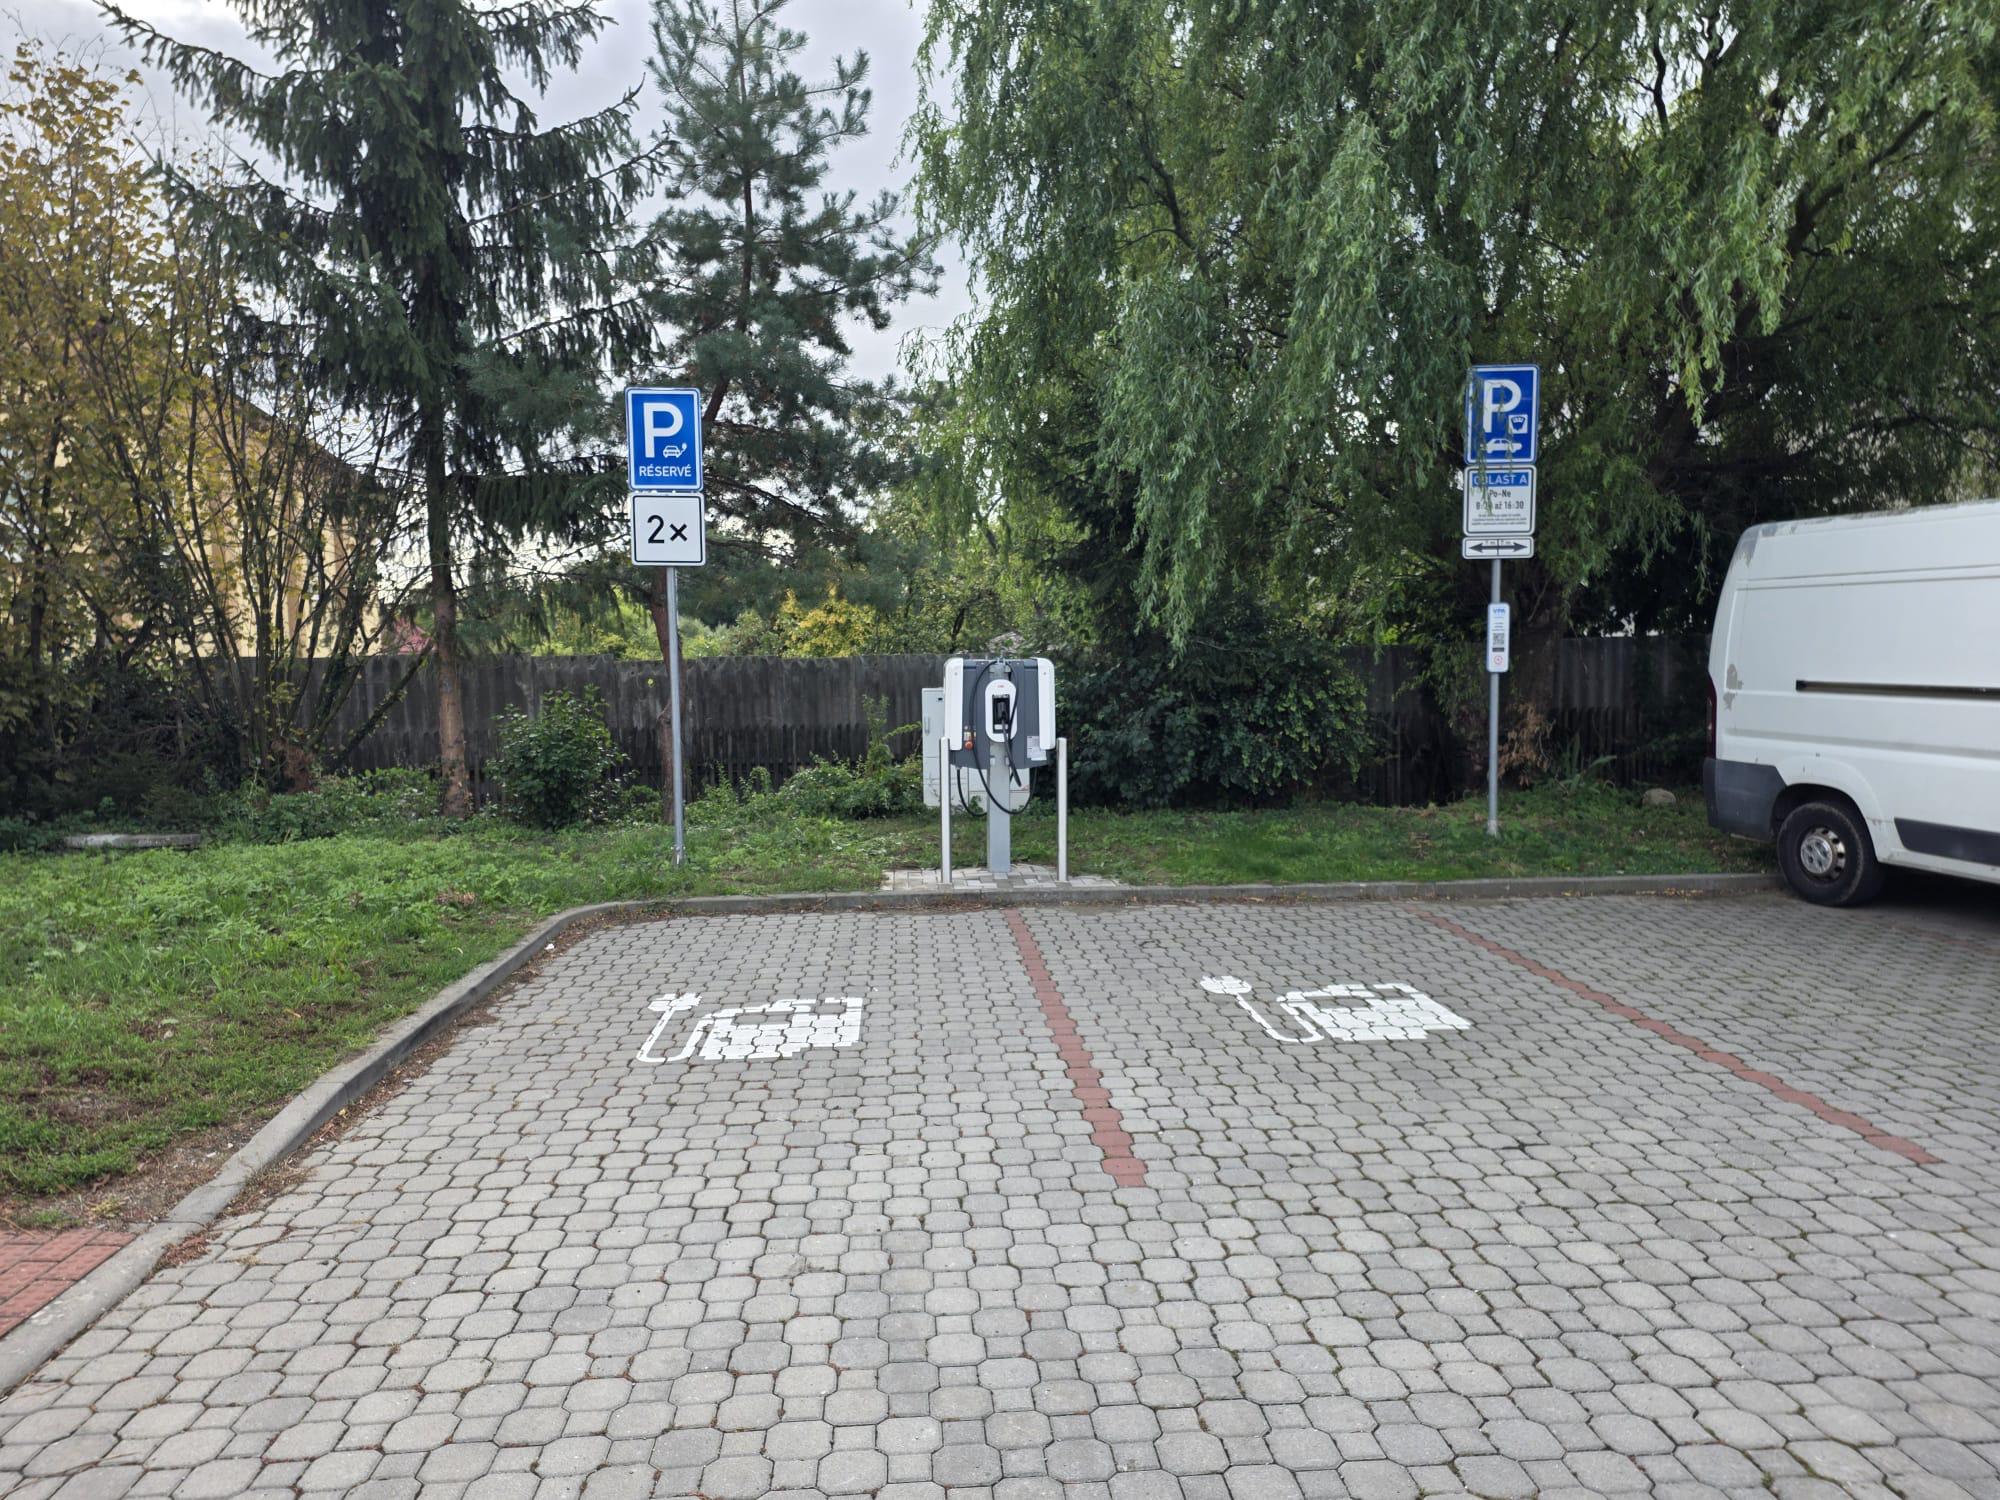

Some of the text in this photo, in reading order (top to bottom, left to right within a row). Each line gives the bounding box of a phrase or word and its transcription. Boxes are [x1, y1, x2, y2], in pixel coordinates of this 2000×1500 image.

[1481, 379, 1522, 433] P
[643, 402, 684, 459] P
[639, 464, 692, 478] RÉSERVÉ
[1519, 474, 1528, 484] A
